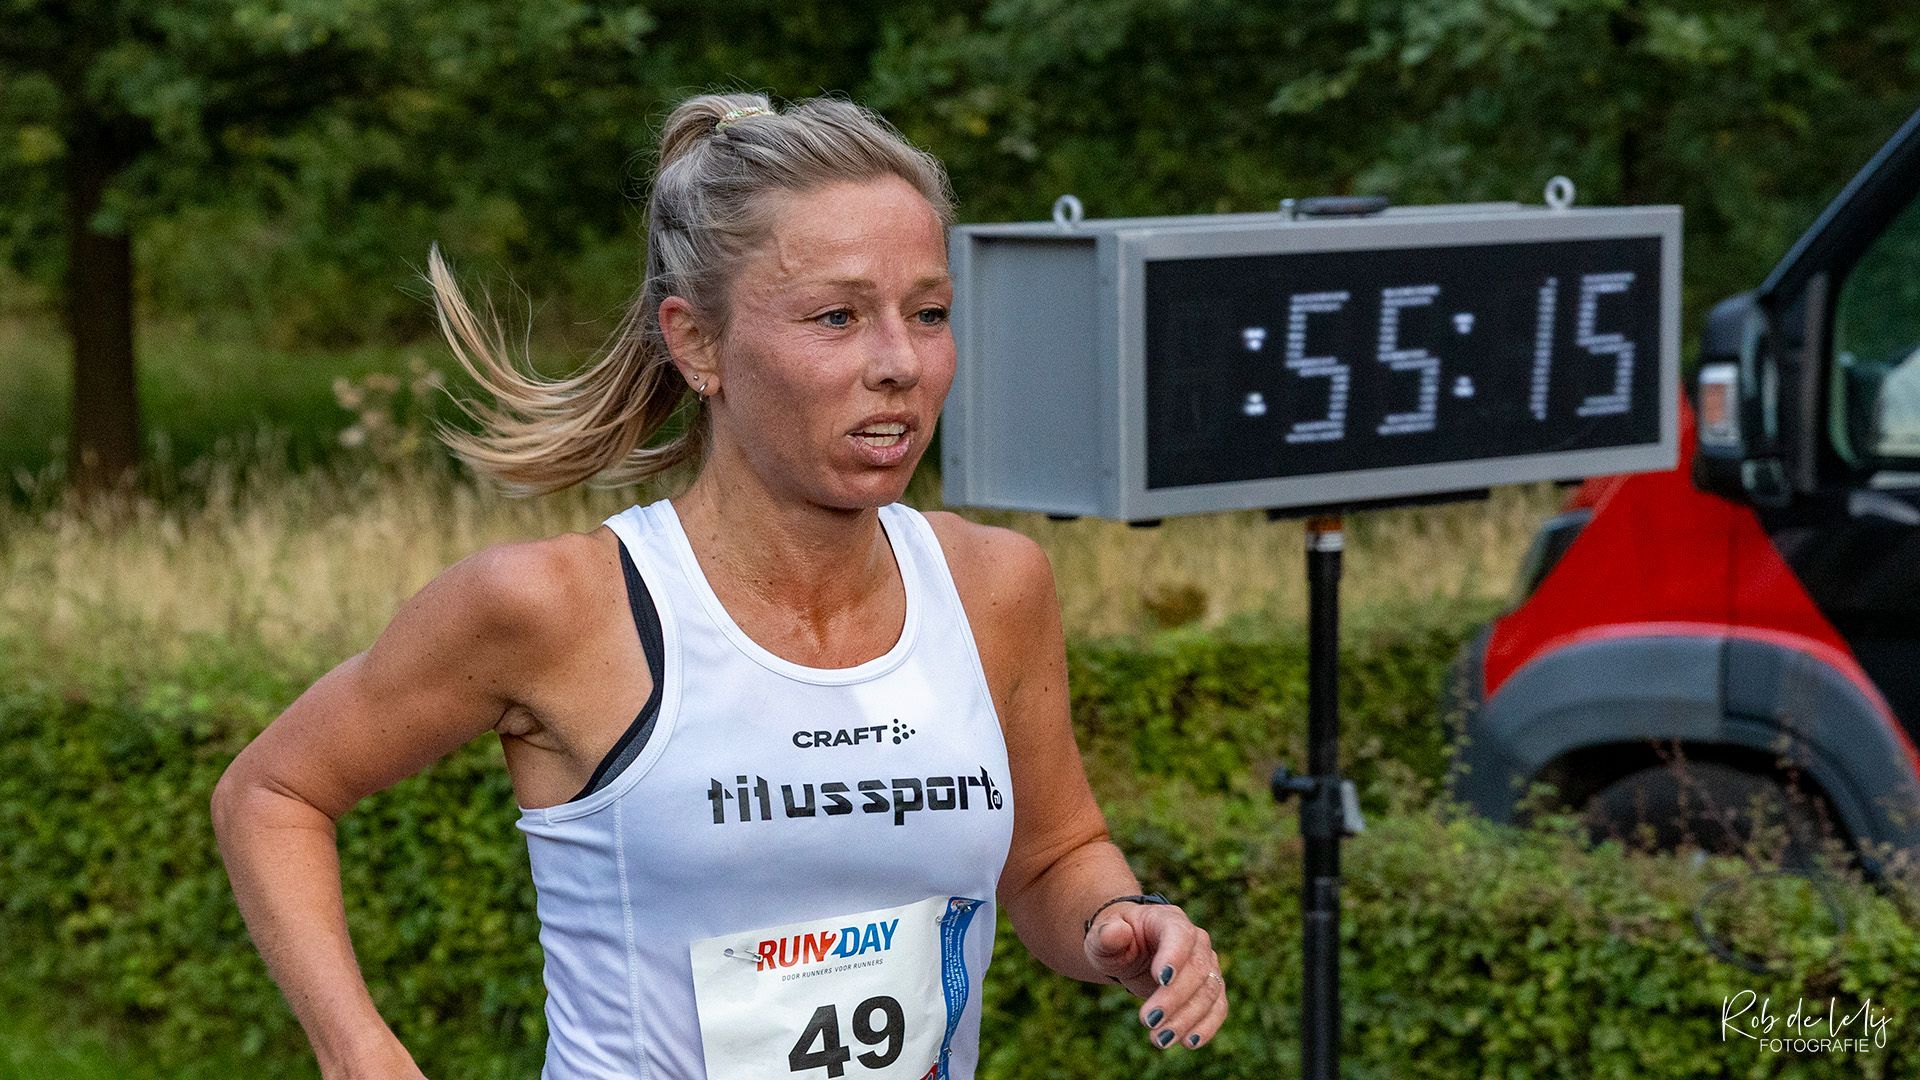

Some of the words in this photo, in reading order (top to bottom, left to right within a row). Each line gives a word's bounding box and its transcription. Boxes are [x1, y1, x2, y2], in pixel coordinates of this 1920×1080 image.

[792, 725, 888, 748] CRAFT
[707, 765, 995, 826] titussport
[757, 918, 899, 972] RUN2DAY
[781, 974, 801, 983] DOOR
[802, 967, 833, 979] RUNNERS
[834, 964, 852, 973] VOOR
[853, 958, 884, 969] RUNNERS
[788, 995, 905, 1079] 49
